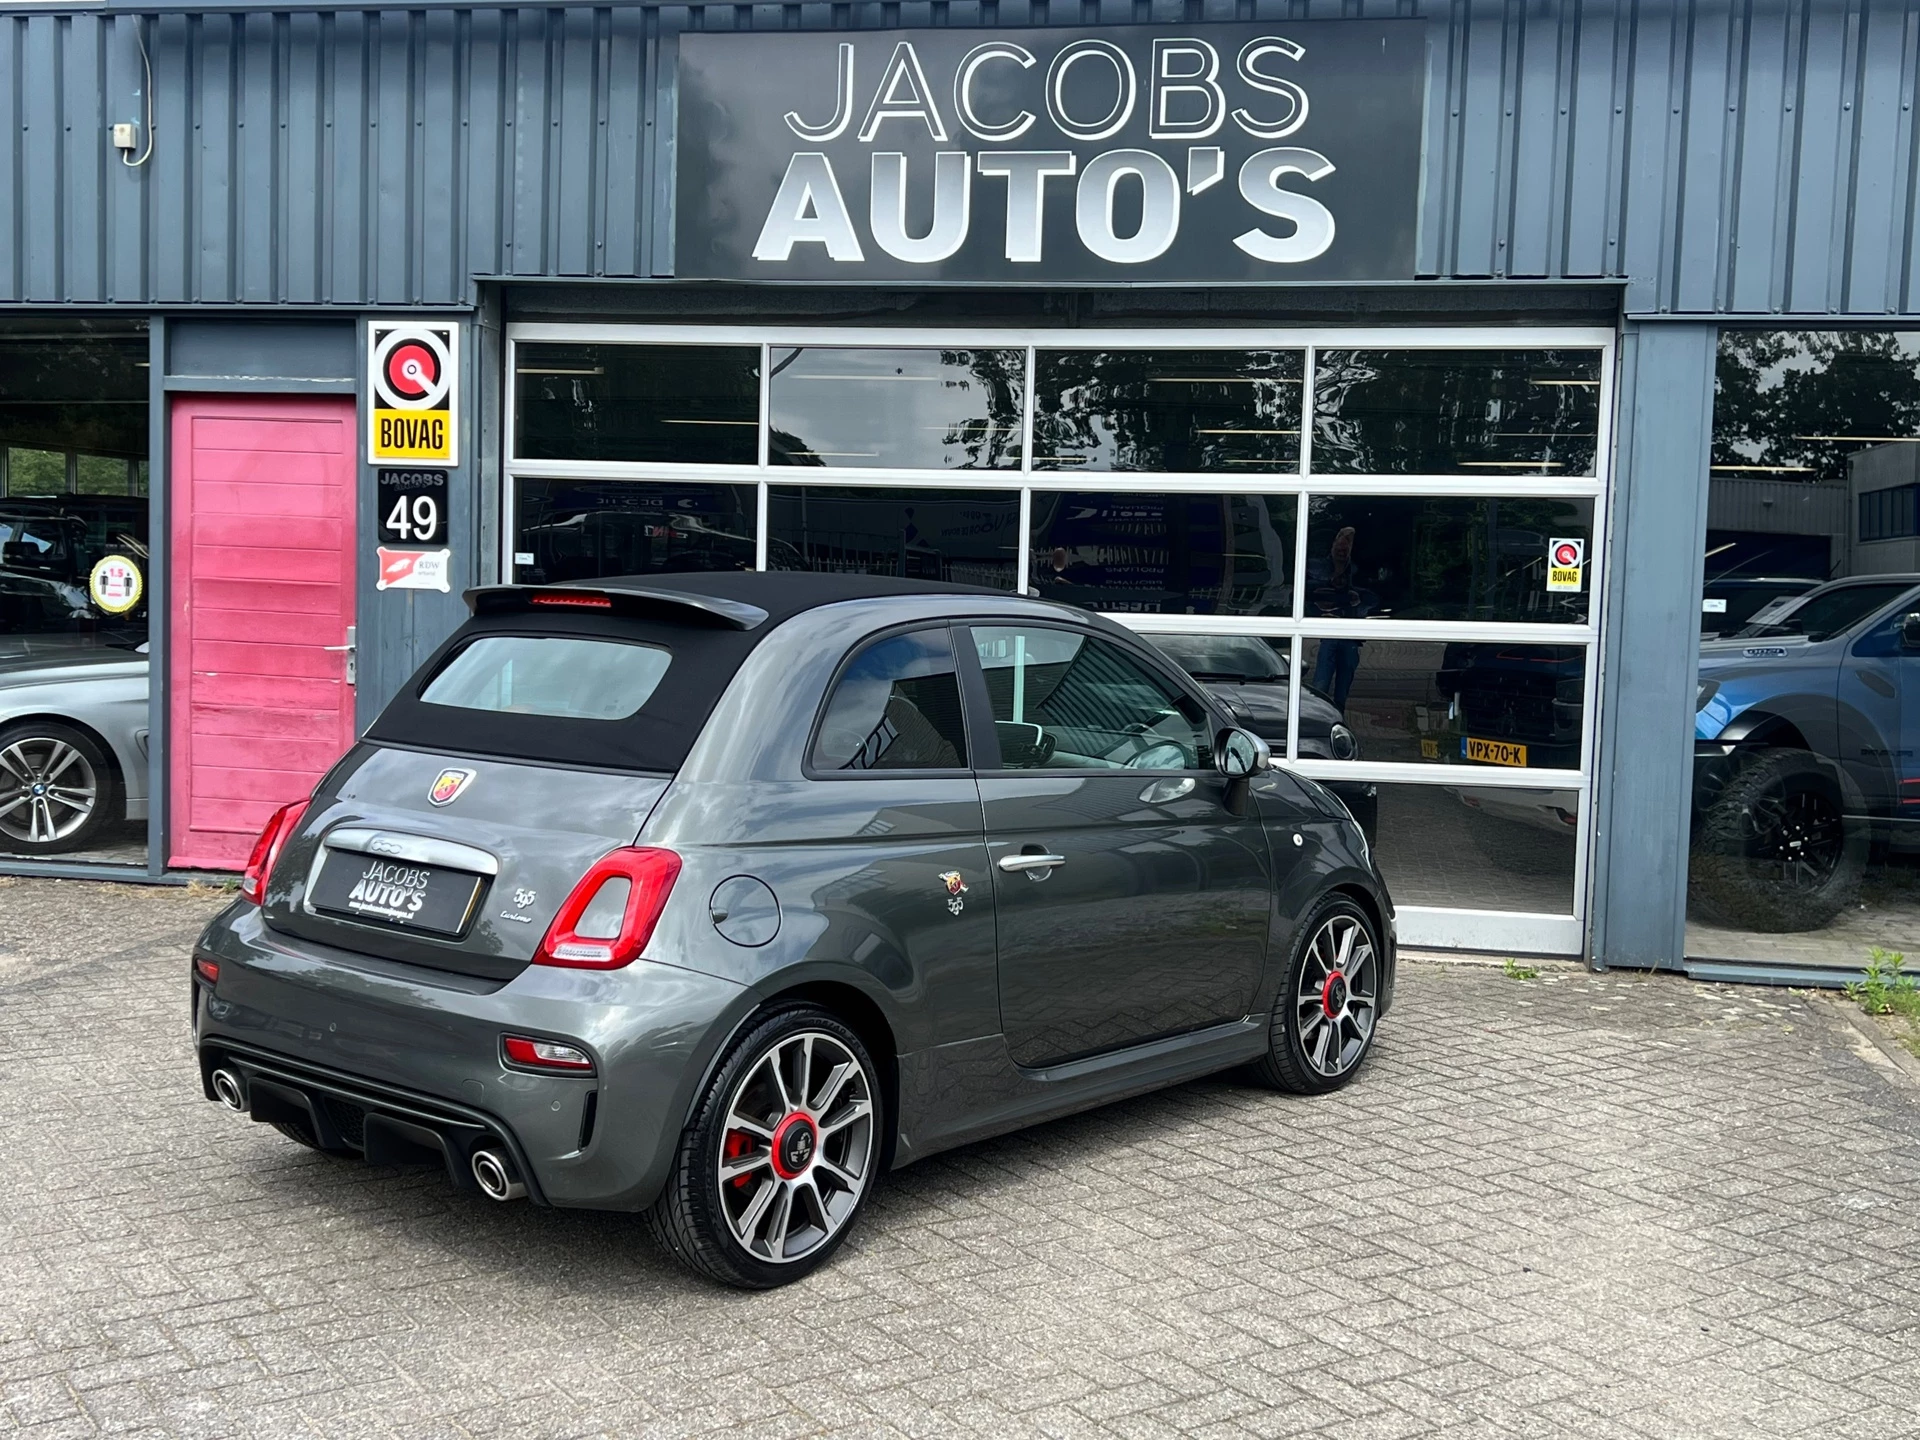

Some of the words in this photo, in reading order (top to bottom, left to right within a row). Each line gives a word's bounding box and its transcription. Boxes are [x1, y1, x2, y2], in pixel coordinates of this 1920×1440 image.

[784, 36, 1309, 141] JACOBS
[752, 146, 1336, 262] AUTO'S
[381, 418, 443, 449] BOVAG
[380, 472, 444, 486] JACOBS
[386, 495, 437, 540] 49
[418, 561, 440, 569] RDW
[1552, 570, 1577, 583] BOVAG
[1469, 740, 1521, 764] VPX-70-K
[362, 861, 430, 889] JACOBS
[348, 878, 427, 911] AUTO'S
[513, 888, 537, 909] 595
[947, 896, 964, 916] 595
